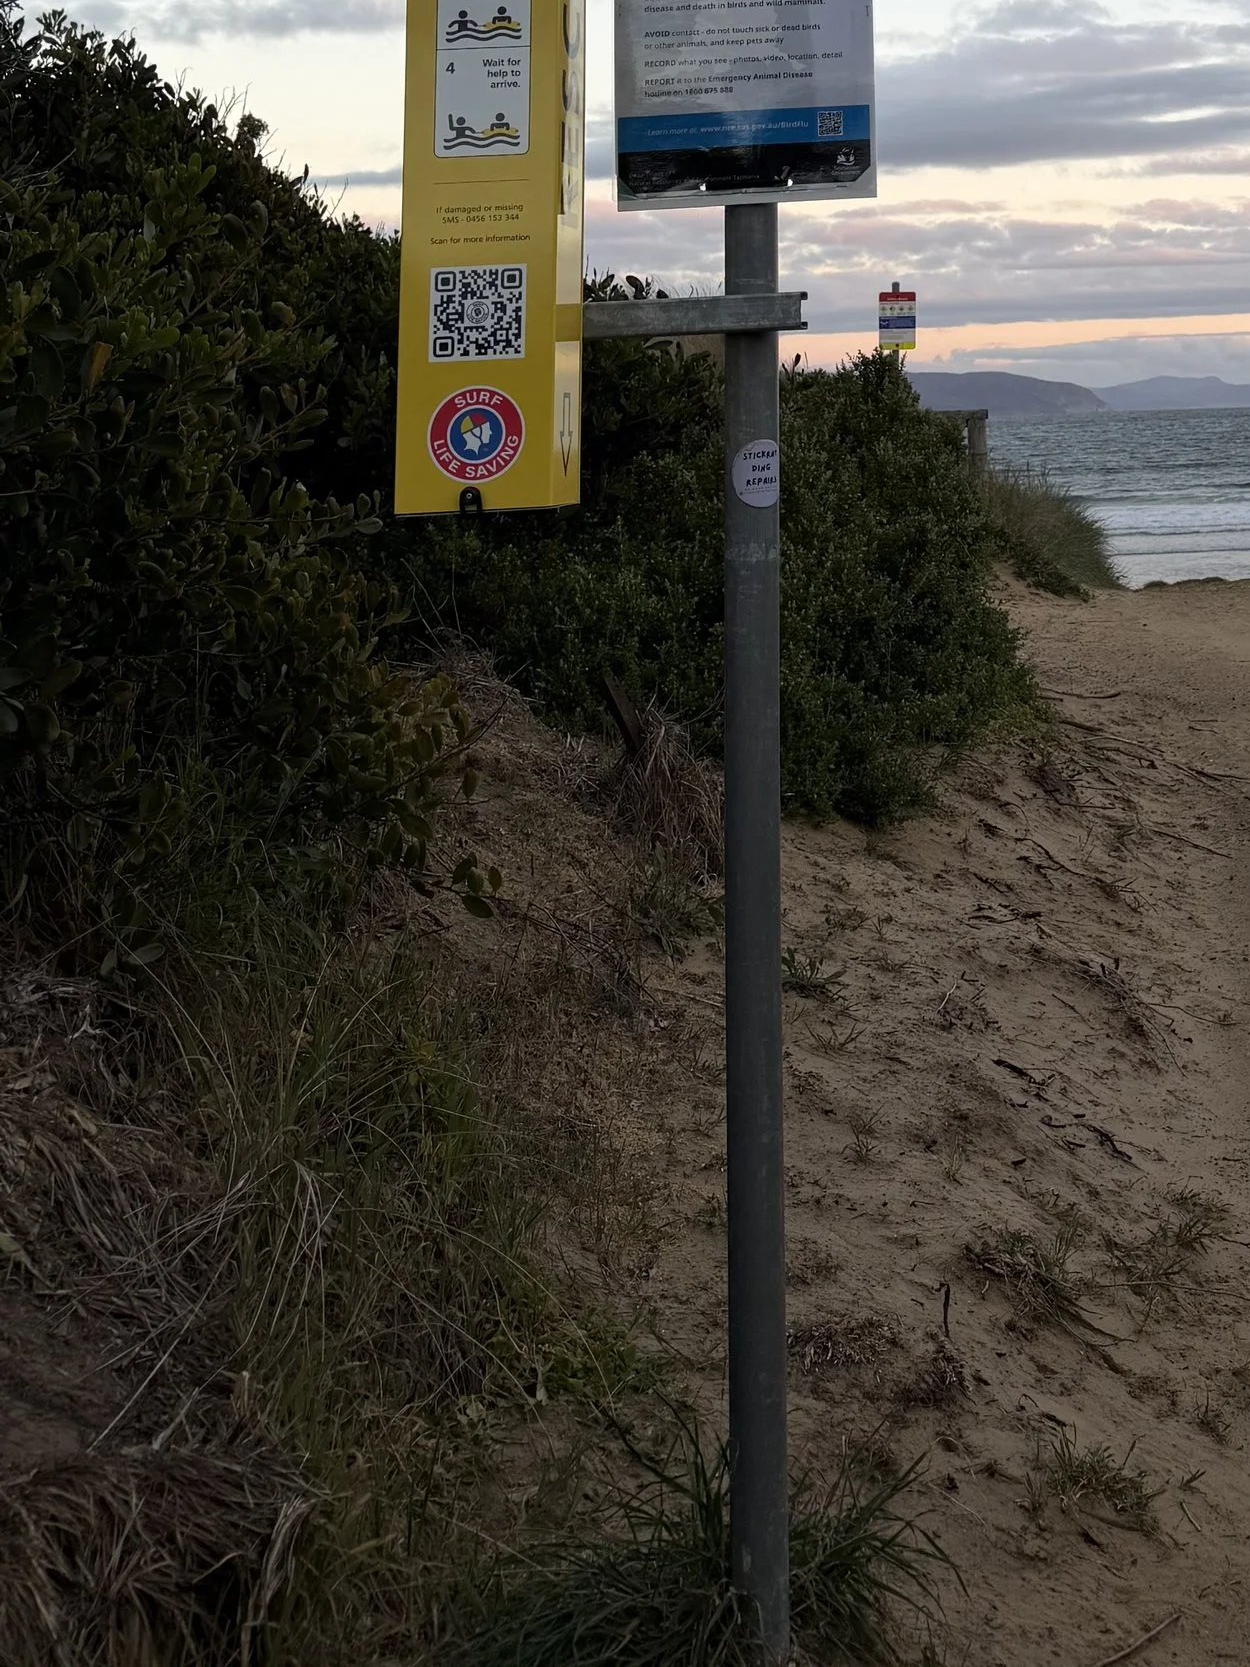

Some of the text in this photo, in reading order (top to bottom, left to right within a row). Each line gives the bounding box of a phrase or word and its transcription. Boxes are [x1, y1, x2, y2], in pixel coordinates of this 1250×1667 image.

[644, 5, 674, 13] disease
[644, 30, 670, 38] AVOID
[755, 25, 769, 33] sick
[654, 42, 674, 50] other
[726, 38, 744, 46] keep
[746, 37, 762, 45] pets
[764, 37, 784, 45] away
[446, 62, 455, 74] 4
[483, 58, 521, 67] Wait for
[678, 58, 697, 66] what
[698, 58, 712, 67] you
[487, 70, 508, 78] help
[644, 78, 675, 86] REPORT
[708, 73, 752, 83] Emergency
[753, 72, 781, 80] Animal
[783, 71, 813, 79] Disease
[490, 80, 520, 88] arrive.
[445, 205, 481, 214] damaged
[495, 204, 524, 212] missing
[442, 216, 459, 224] SMS
[489, 214, 502, 222] 153
[505, 213, 519, 221] 344
[430, 237, 448, 245] Scan
[450, 236, 461, 244] for
[485, 233, 531, 242] information
[455, 391, 503, 408] SURF
[434, 435, 519, 478] LIFE SAVING
[752, 463, 771, 473] DING
